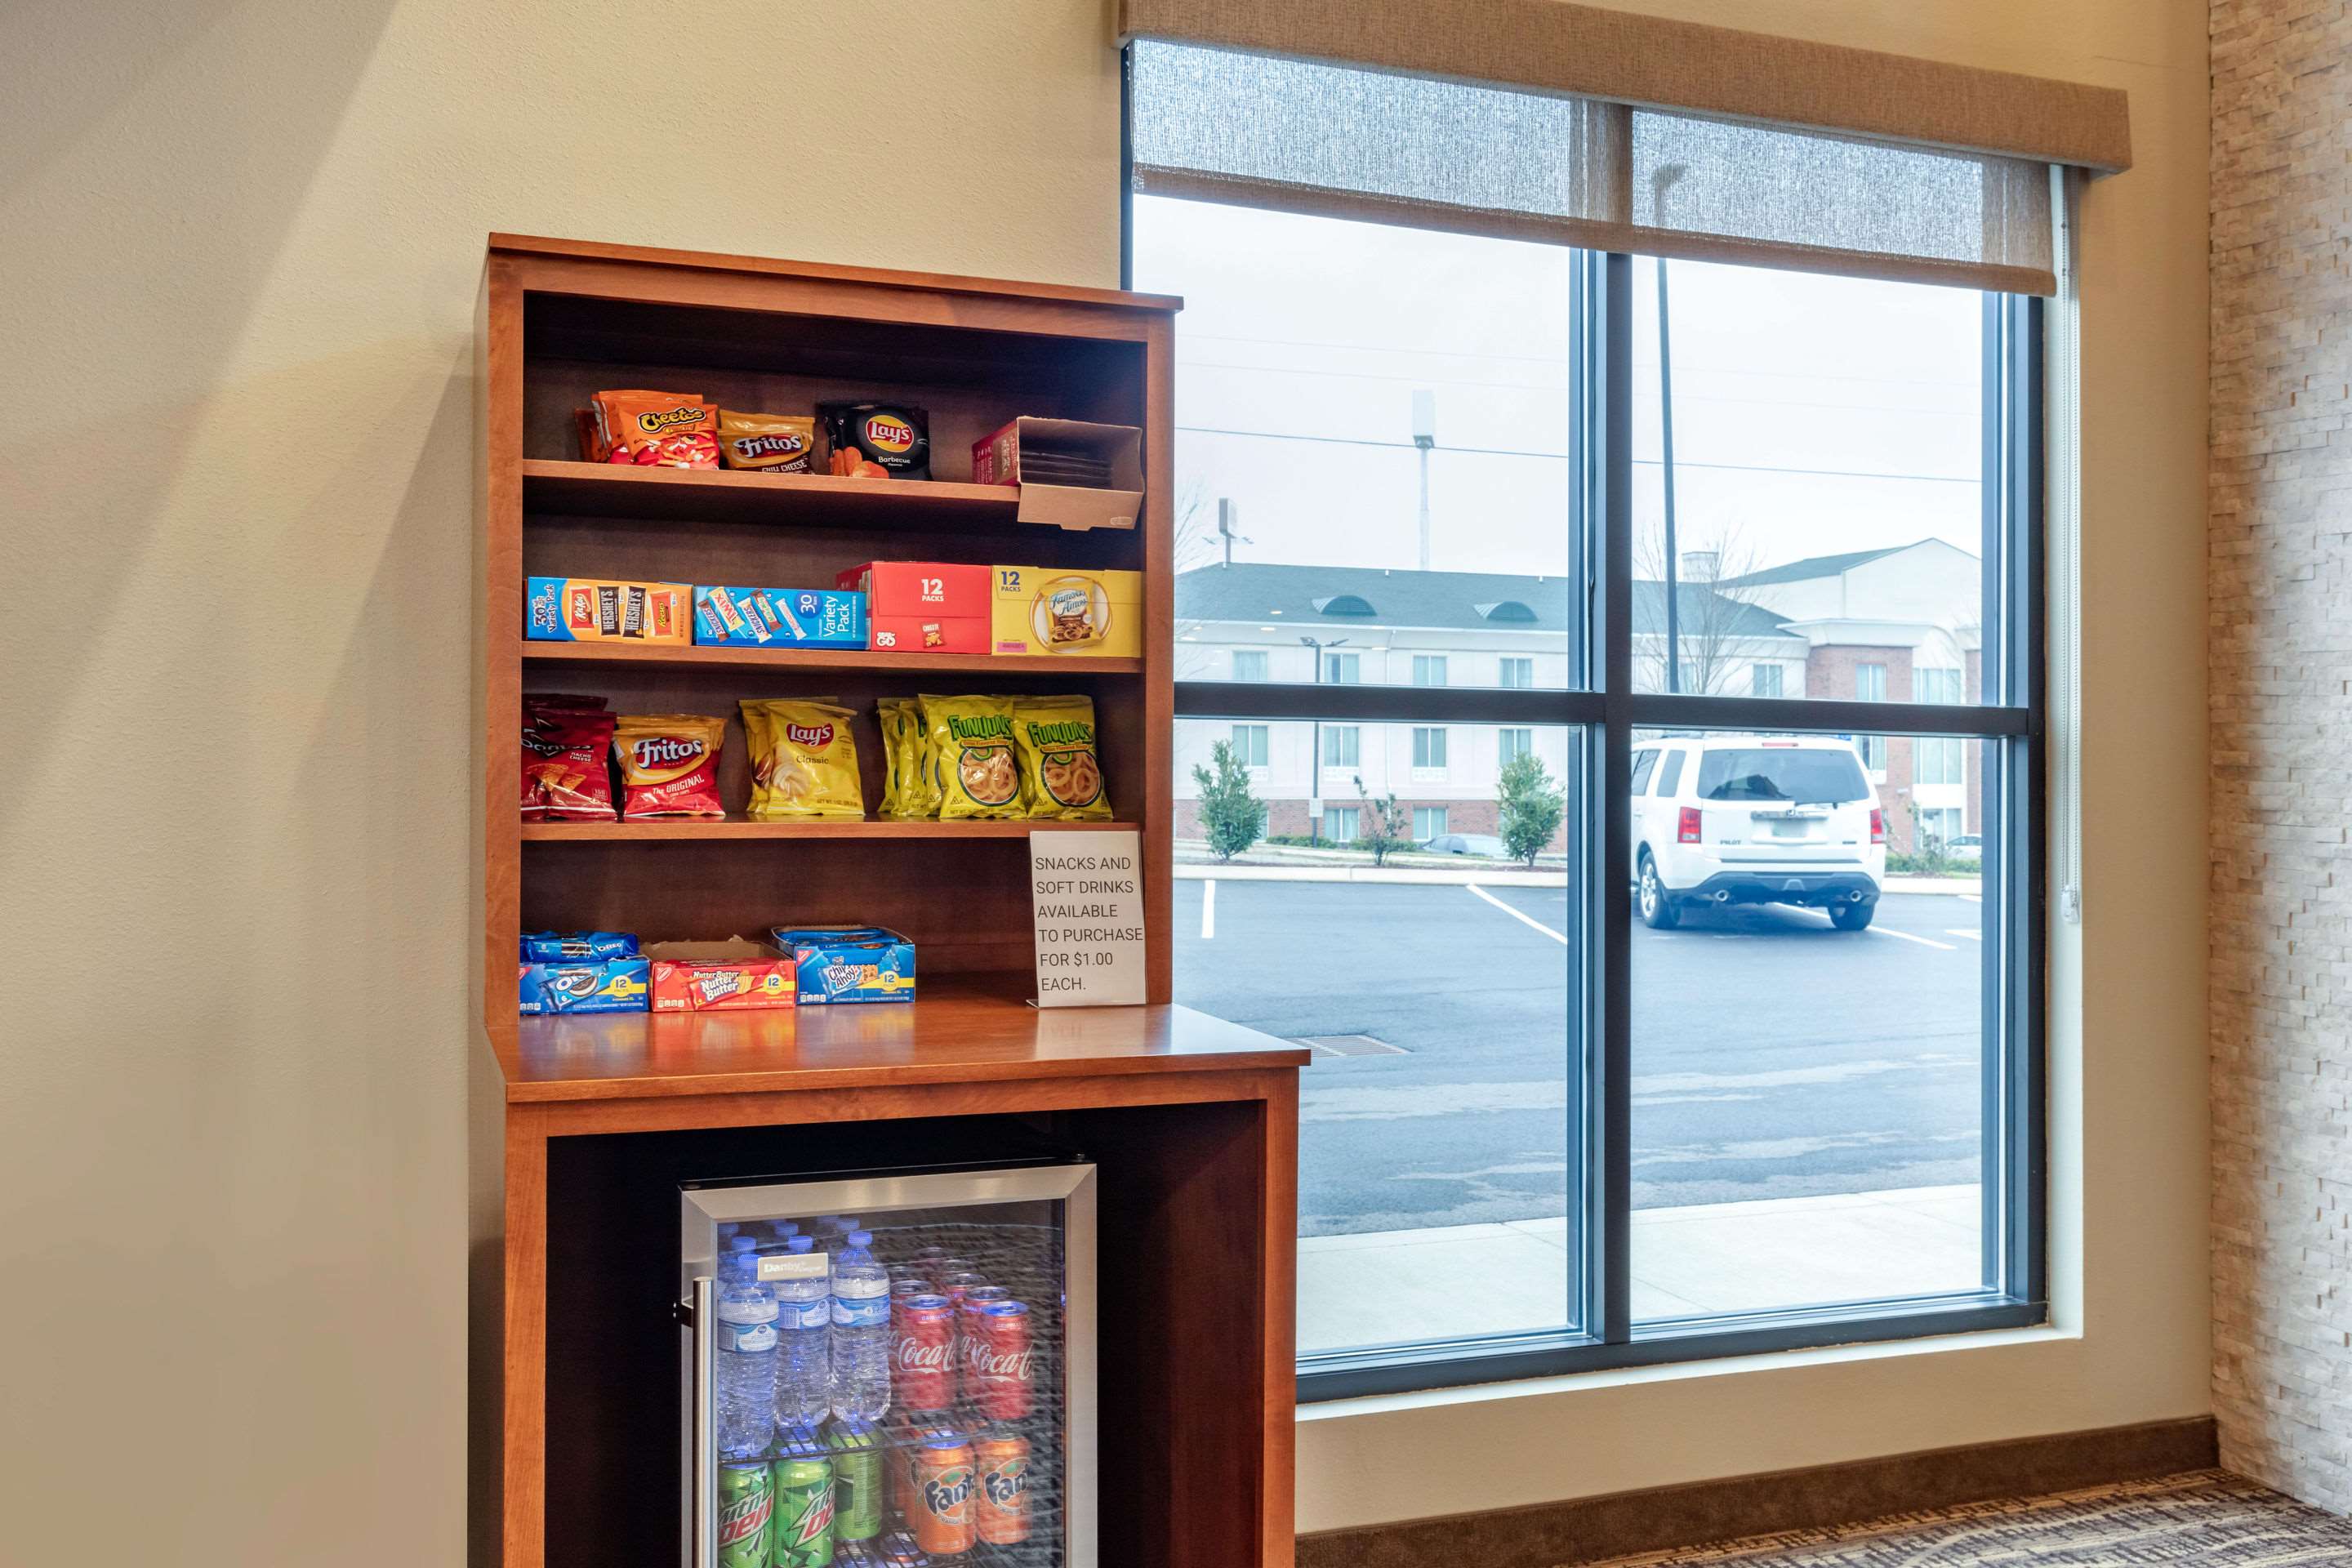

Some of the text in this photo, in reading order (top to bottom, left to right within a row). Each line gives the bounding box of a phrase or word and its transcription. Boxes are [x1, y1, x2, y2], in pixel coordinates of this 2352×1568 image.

[639, 408, 705, 432] Cheetos
[871, 421, 911, 443] Lay's
[733, 434, 803, 458] Fritos
[781, 460, 807, 471] CHEESE
[878, 456, 911, 464] Barbecue
[921, 579, 943, 595] 12
[1001, 572, 1020, 585] 12
[546, 584, 558, 633] Variety Pack
[800, 595, 815, 613] 30
[1051, 590, 1085, 609] Famous
[533, 604, 548, 627] 30
[601, 590, 615, 630] HERSHEY'S
[624, 591, 642, 630] HERSHEY'S
[823, 595, 839, 638] Variety
[837, 604, 849, 632] Pack
[704, 608, 724, 634] SNICKERS
[744, 606, 765, 634] SNICKERS
[791, 724, 831, 746] Lay's
[633, 737, 703, 768] Fritos
[796, 755, 829, 764] Classic
[666, 774, 704, 793] ORIGINAL
[1036, 857, 1131, 870] SNACKS AND
[1036, 880, 1134, 893] SOFT DRINKS
[1038, 904, 1118, 918] AVAILABLE
[1039, 928, 1143, 942] TO PURCHASE
[1040, 951, 1113, 967] FOR $1.00
[615, 980, 626, 988] 12
[700, 978, 733, 992] Nutter
[768, 978, 779, 987] 12
[884, 974, 895, 982] 12
[1041, 978, 1086, 991] EACH.
[706, 983, 739, 1001] Butter
[924, 1472, 973, 1515] Fant
